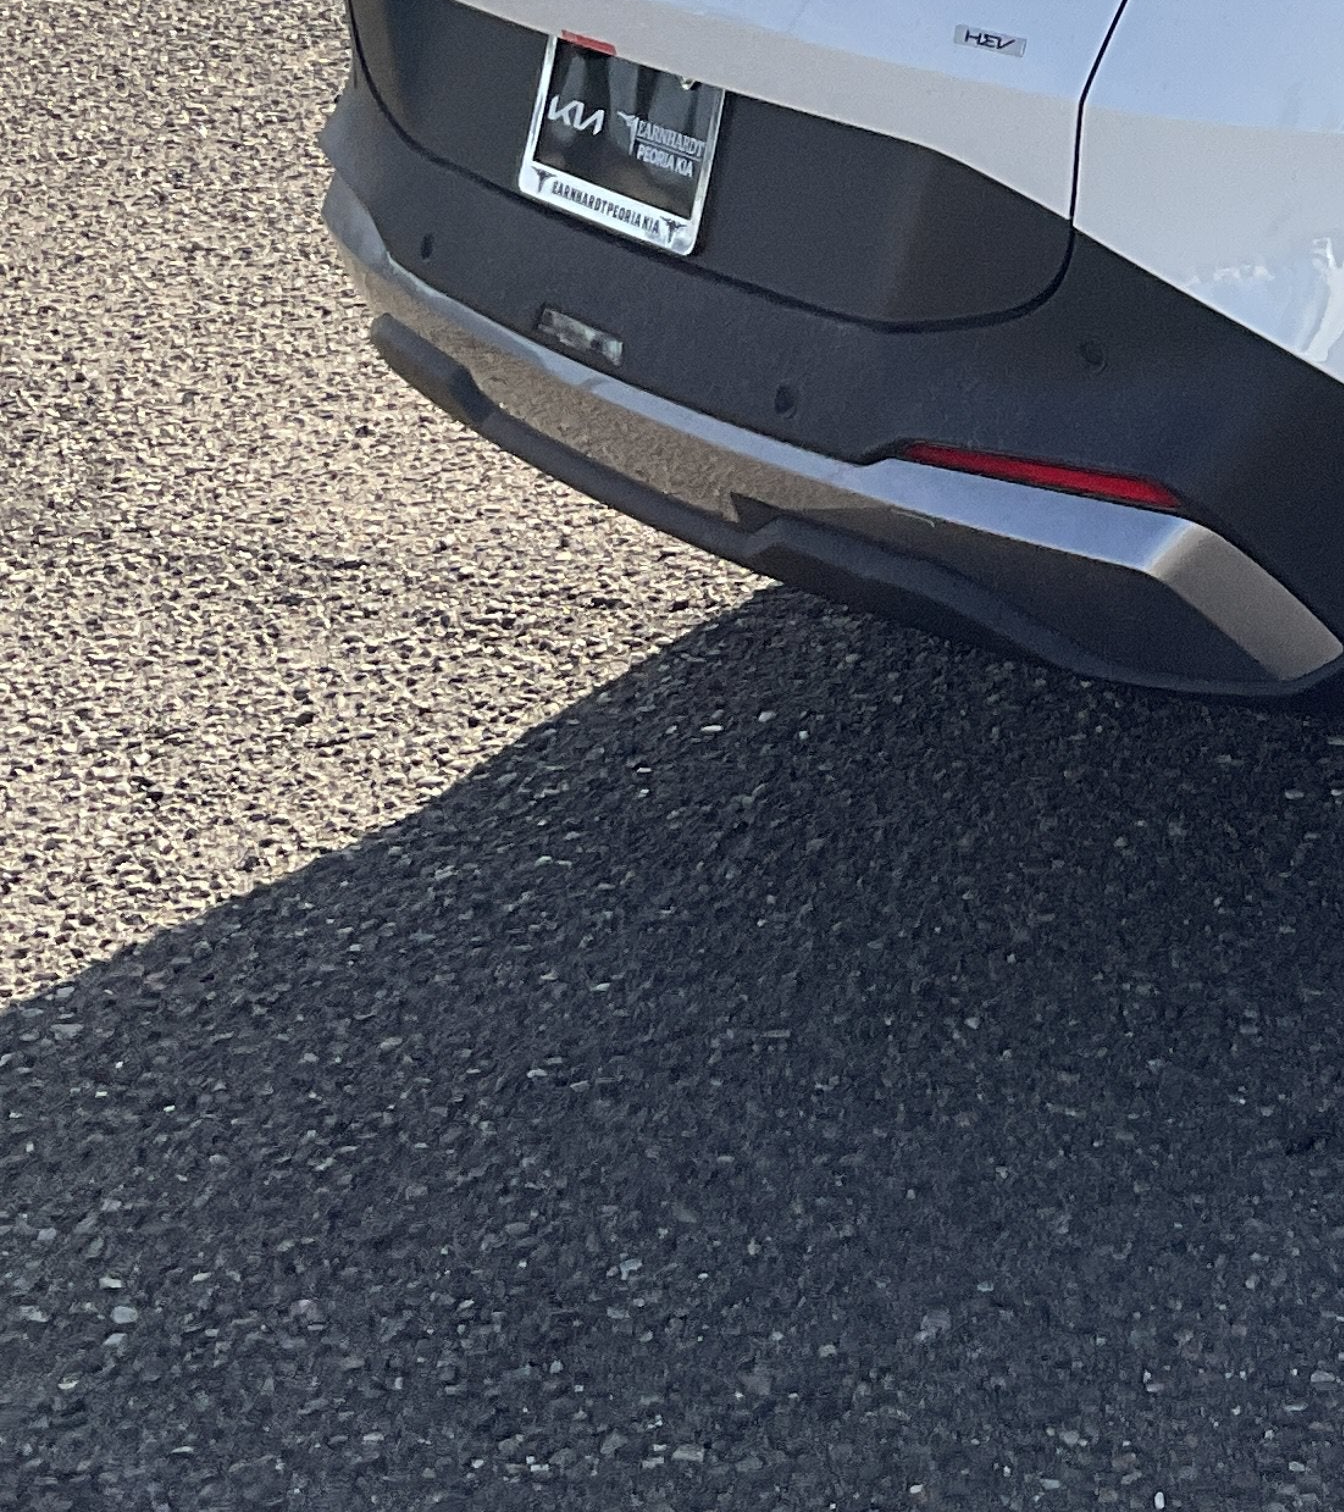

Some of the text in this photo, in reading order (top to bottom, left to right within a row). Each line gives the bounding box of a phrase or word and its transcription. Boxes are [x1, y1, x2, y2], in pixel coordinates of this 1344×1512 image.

[964, 29, 1016, 50] HEV
[547, 94, 605, 136] KIA
[636, 119, 705, 157] EARNHARDT
[636, 144, 694, 178] PEORIA KIA
[641, 215, 660, 234] KIA
